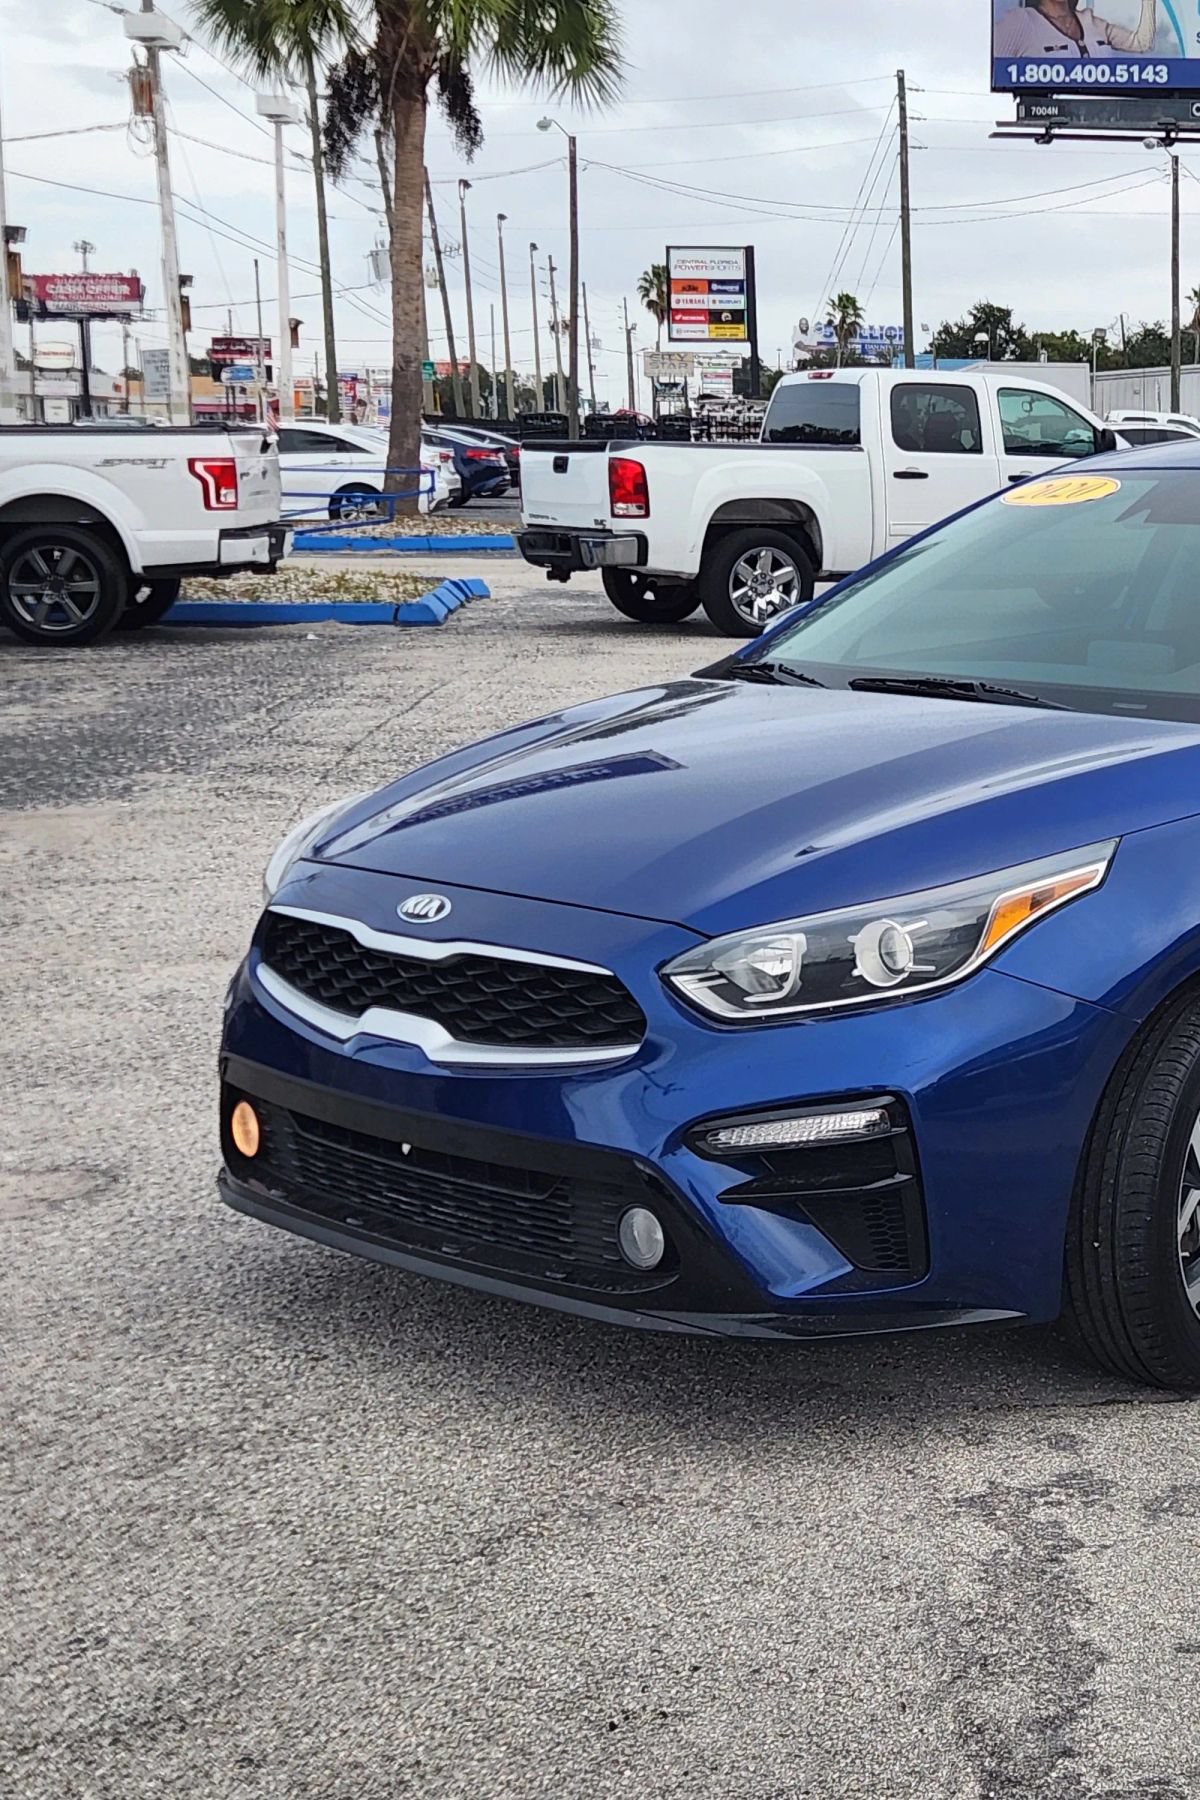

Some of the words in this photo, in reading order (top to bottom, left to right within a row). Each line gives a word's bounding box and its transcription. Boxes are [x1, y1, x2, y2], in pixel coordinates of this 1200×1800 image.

[1007, 64, 1169, 84] 1.800.400.5143
[1031, 106, 1059, 116] 7004N
[400, 896, 444, 919] KIA
